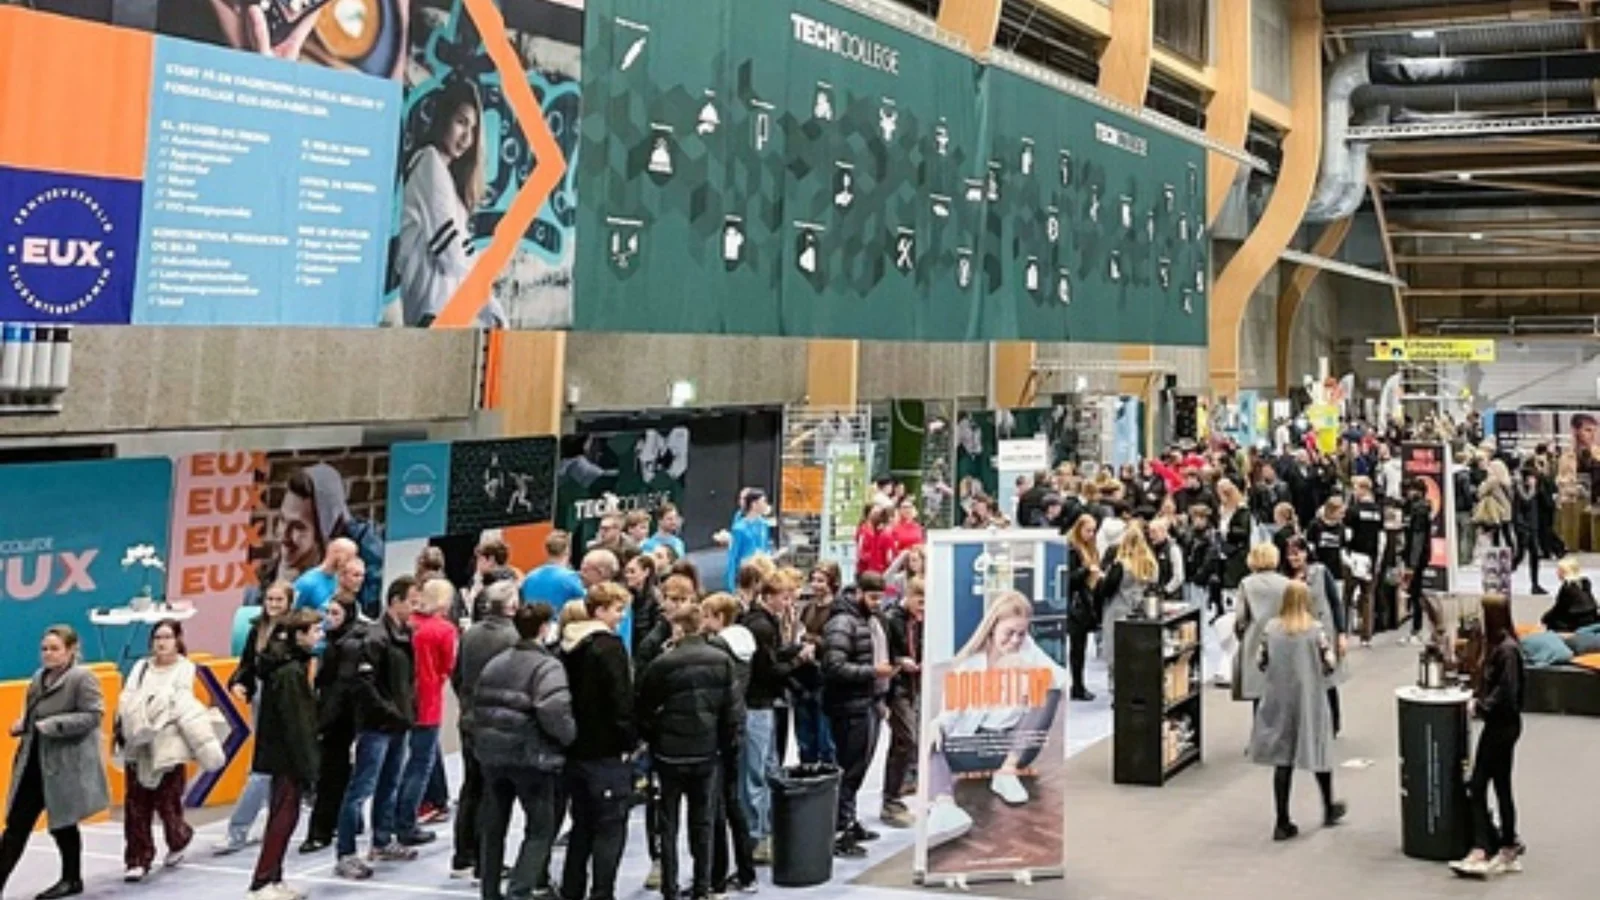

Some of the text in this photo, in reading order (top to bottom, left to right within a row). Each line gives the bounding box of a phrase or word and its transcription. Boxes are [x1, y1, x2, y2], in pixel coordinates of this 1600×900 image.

[22, 236, 103, 267] EUX
[191, 450, 268, 477] EUX
[186, 484, 265, 515] EUX
[183, 522, 263, 556] EUX
[0, 548, 98, 600] UX
[180, 560, 261, 596] EUX
